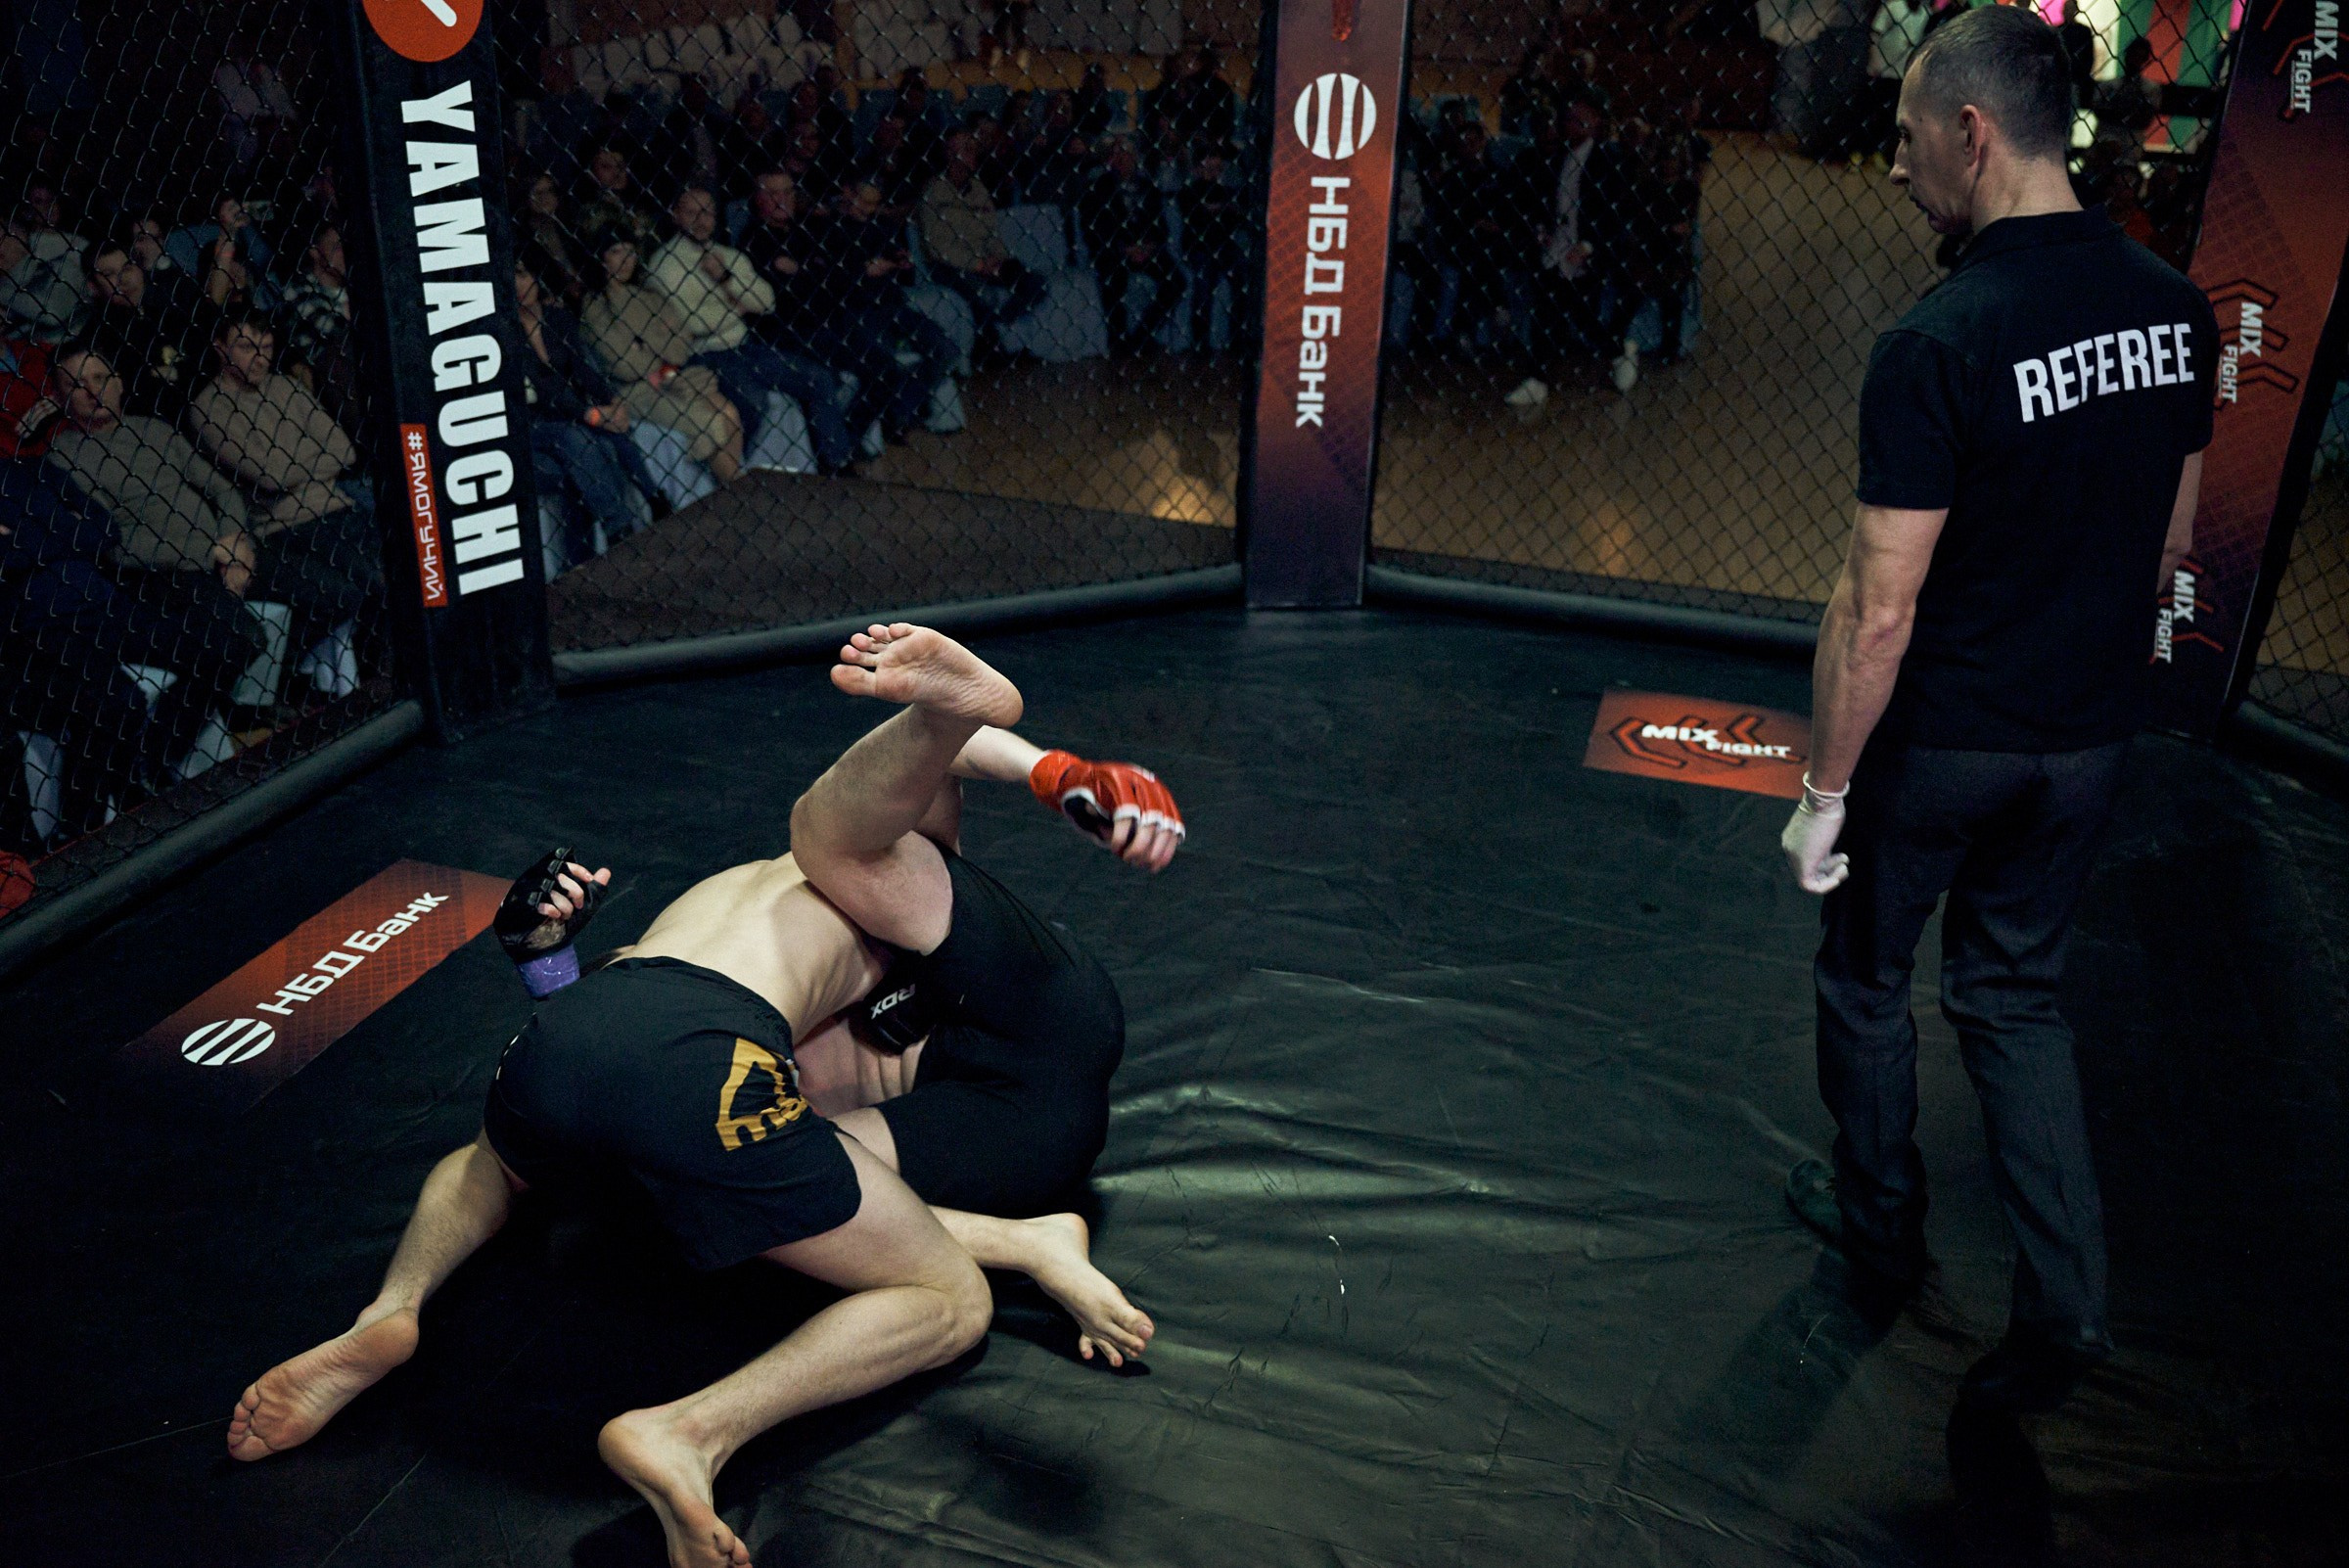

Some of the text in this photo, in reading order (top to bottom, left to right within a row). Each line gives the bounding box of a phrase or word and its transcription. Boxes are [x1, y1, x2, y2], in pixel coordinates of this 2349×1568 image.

[2313, 0, 2340, 62] MIX
[2295, 48, 2313, 115] FIGHT
[1295, 176, 1351, 429] НБД Банк
[2239, 301, 2263, 358] MIX
[400, 80, 525, 596] YAMAGUCHI
[2013, 323, 2195, 423] REFEREE
[2219, 343, 2239, 404] FIGHT
[2172, 570, 2195, 623] MIX
[2157, 608, 2173, 664] FIGHT
[1641, 724, 1718, 743] MIX
[1705, 741, 1791, 758] FIGHT
[256, 891, 449, 1016] НБД Банк
[870, 984, 916, 1020] RDX
